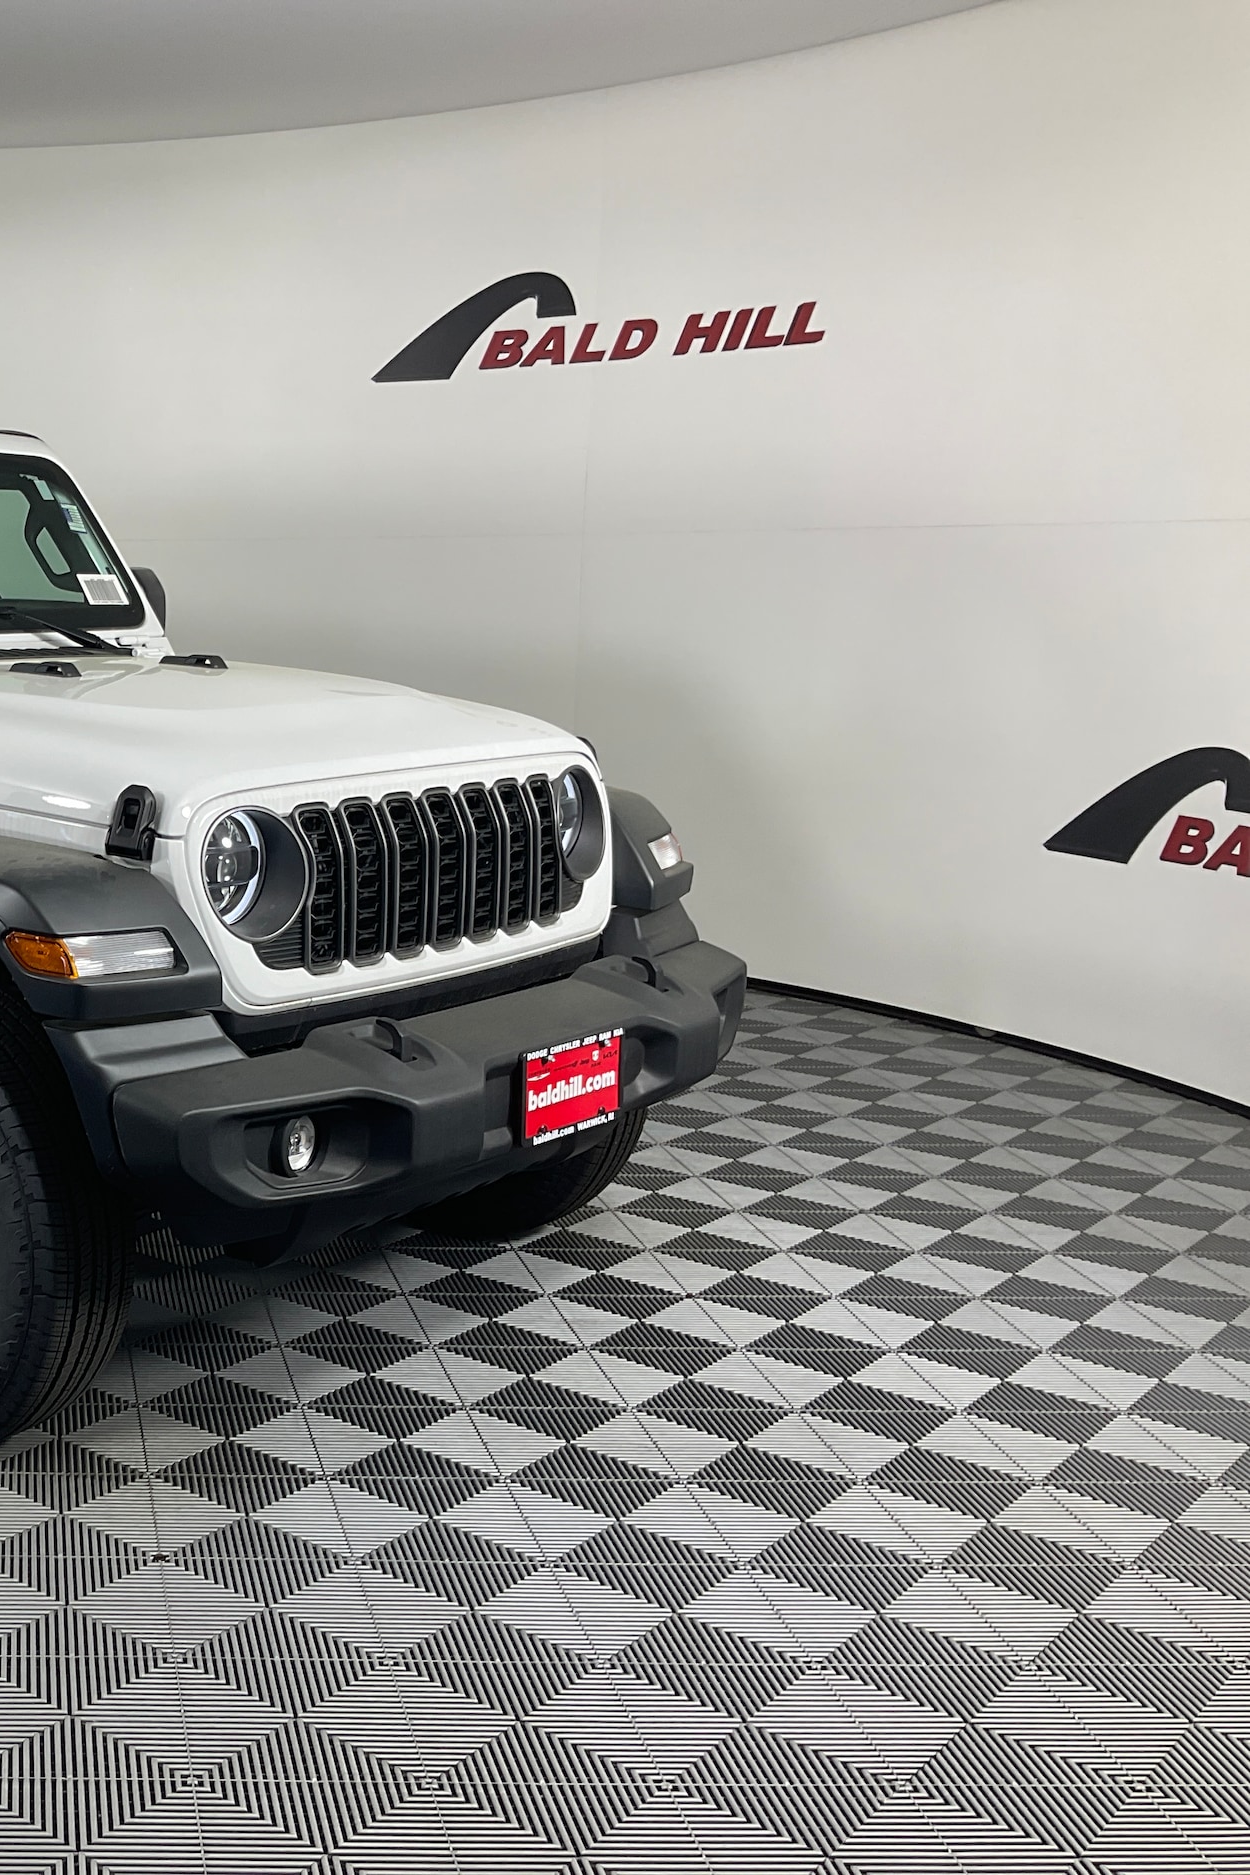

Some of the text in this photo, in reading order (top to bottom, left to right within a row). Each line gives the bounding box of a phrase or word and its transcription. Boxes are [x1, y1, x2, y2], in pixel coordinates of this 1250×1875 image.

[478, 301, 826, 370] BALD HILL
[527, 1048, 548, 1061] DODGE
[550, 1040, 581, 1054] CHRYSLER
[582, 1035, 597, 1046] JEEP
[599, 1031, 612, 1041] RAM
[527, 1069, 616, 1112] baldhill.com
[532, 1125, 575, 1146] baldhill.com
[608, 1112, 615, 1121] RI
